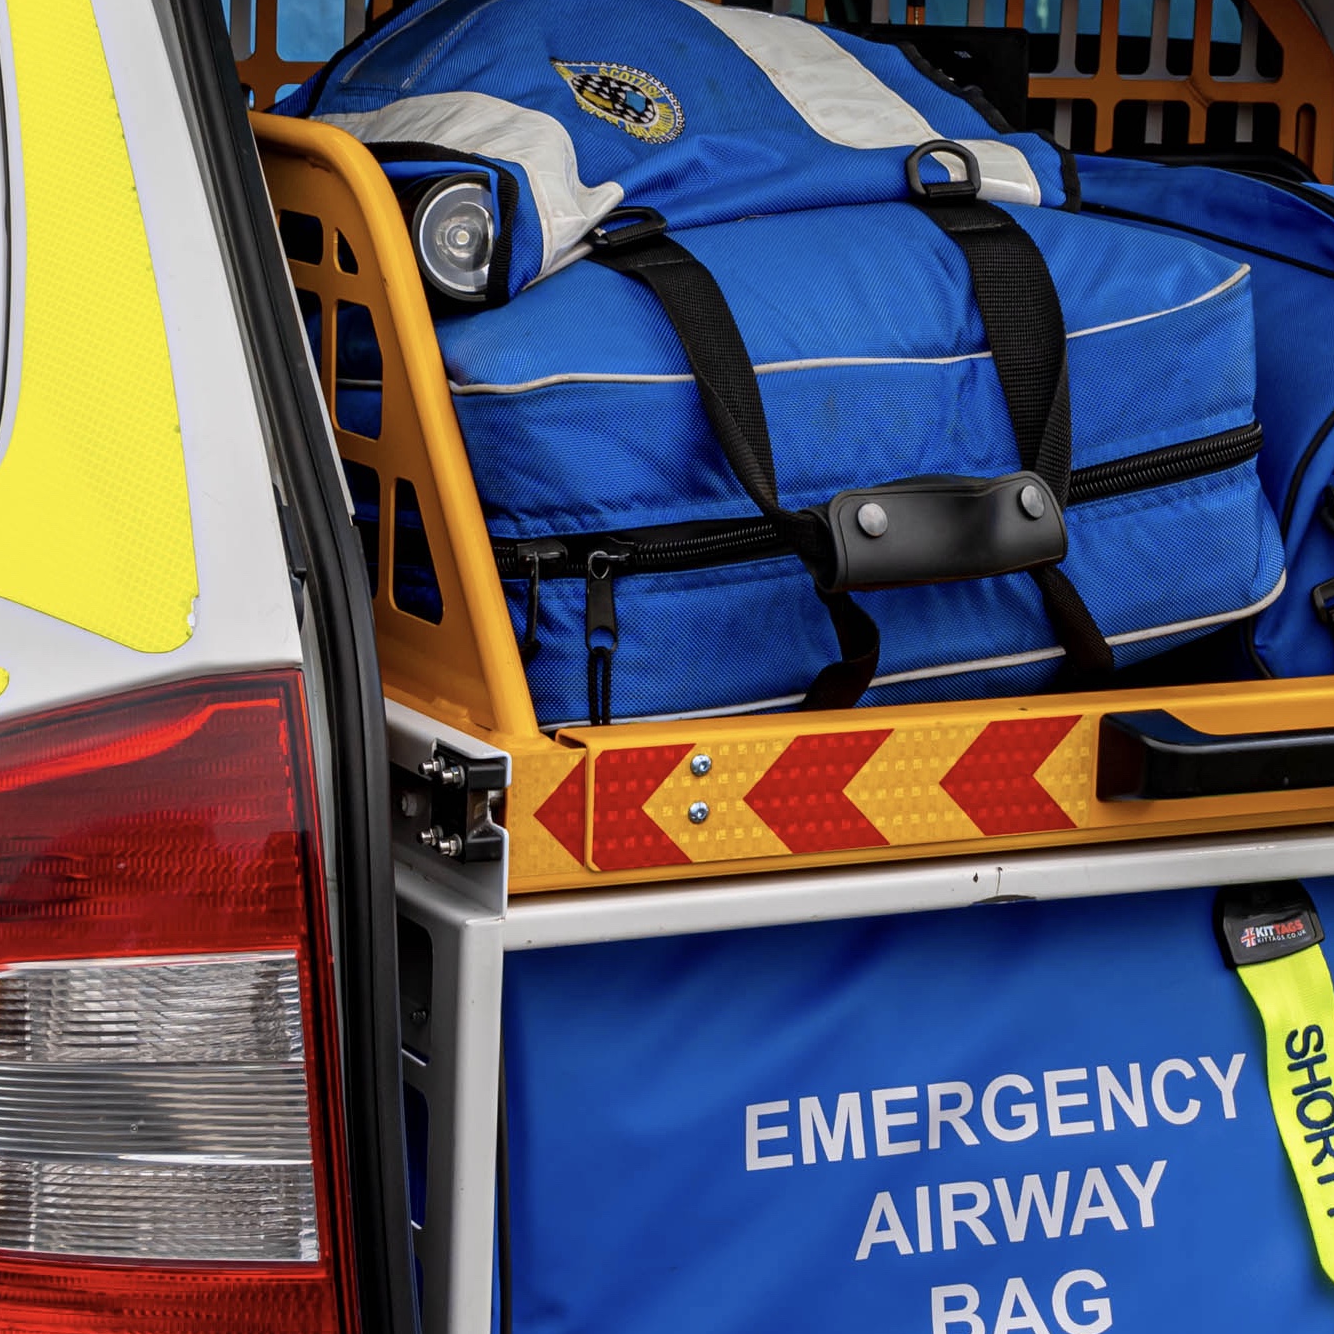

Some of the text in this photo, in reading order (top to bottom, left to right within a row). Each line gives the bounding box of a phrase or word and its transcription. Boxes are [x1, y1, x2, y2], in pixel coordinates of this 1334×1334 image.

[1255, 919, 1304, 938] KITTAGS
[745, 1053, 1247, 1172] EMERGENCY
[854, 1160, 1168, 1261] AIRWAY
